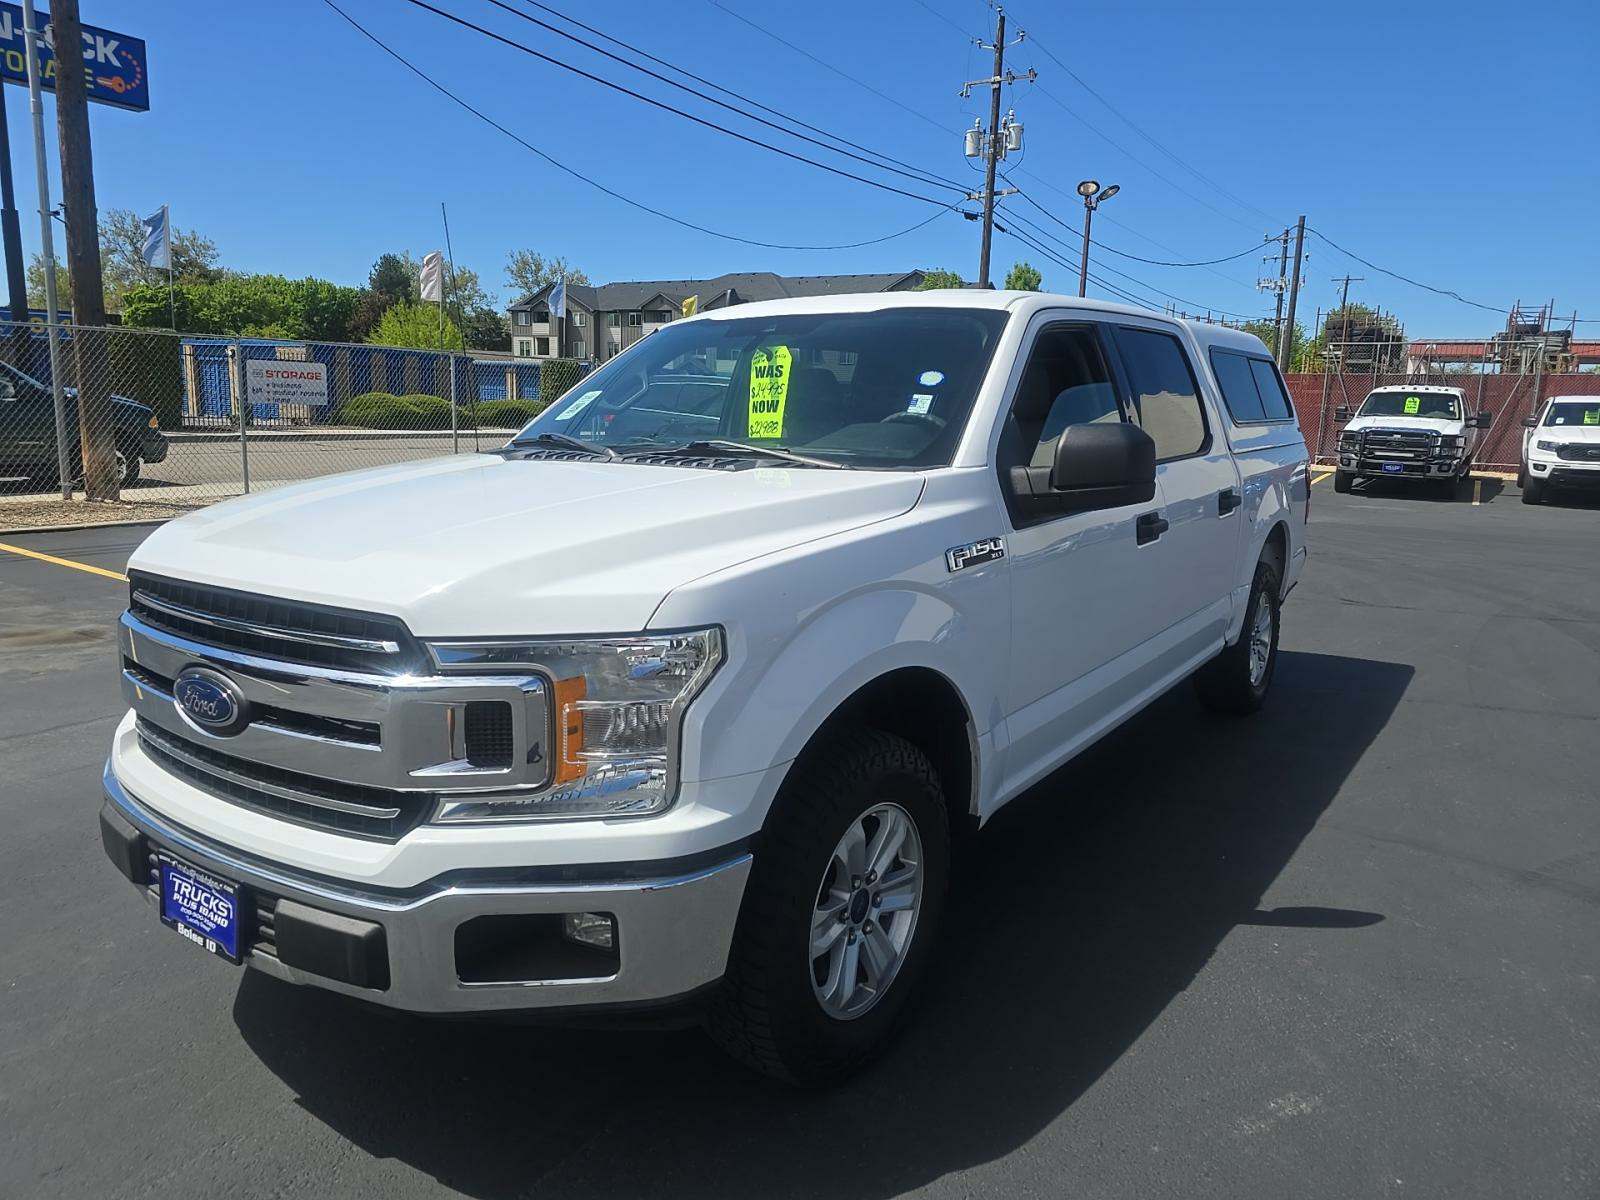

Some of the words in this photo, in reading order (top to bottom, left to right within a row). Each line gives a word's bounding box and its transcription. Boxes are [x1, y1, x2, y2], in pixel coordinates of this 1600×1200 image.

[265, 369, 322, 380] STORAGE
[755, 364, 784, 379] WAS
[752, 399, 780, 414] NOW
[184, 684, 218, 716] Ford
[172, 877, 229, 917] TRUCKS
[173, 893, 198, 910] PLUS
[199, 905, 229, 928] IDAHO
[177, 922, 204, 946] Boise
[205, 938, 217, 953] ID
